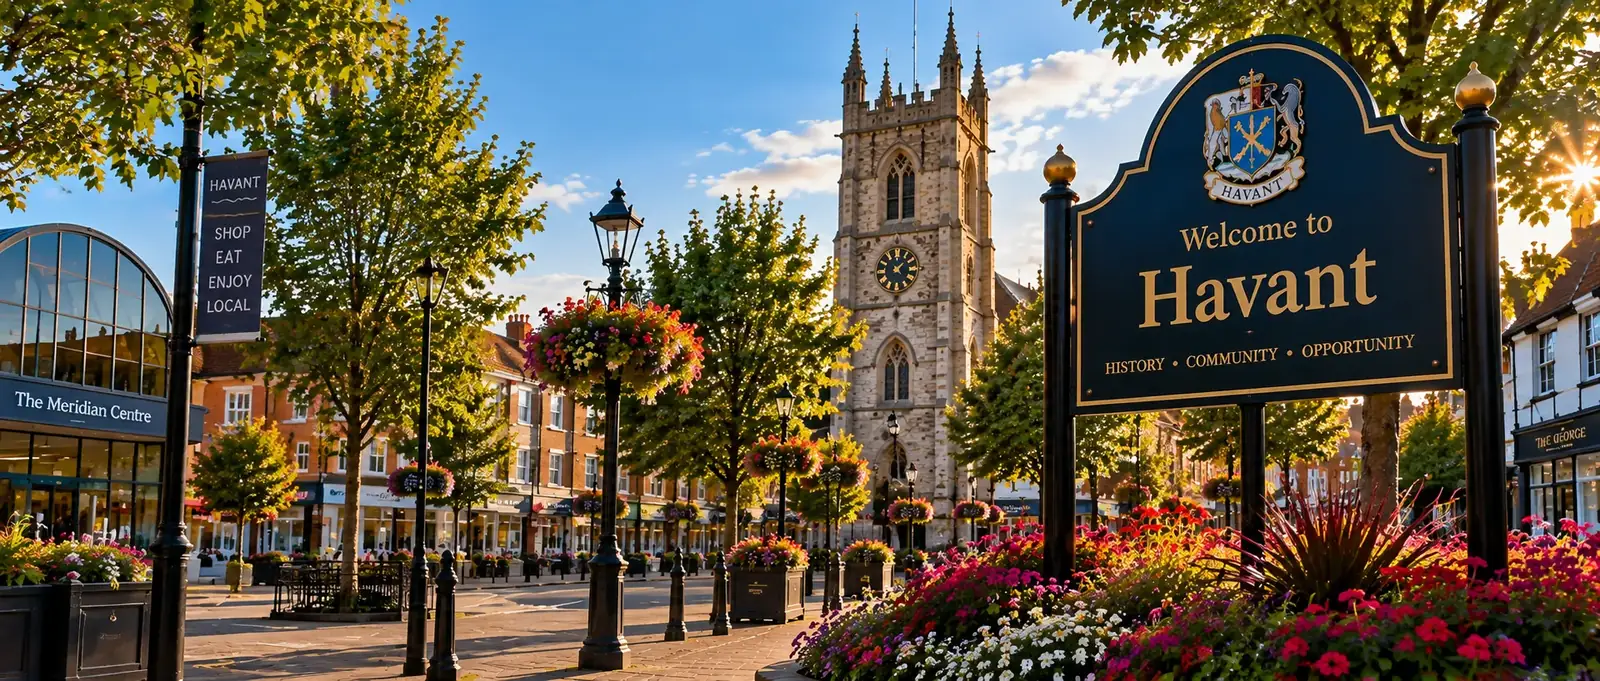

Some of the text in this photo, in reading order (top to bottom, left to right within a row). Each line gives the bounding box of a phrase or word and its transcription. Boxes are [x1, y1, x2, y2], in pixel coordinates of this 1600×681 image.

[209, 176, 261, 192] HAVANT
[1221, 177, 1283, 200] HAVANT
[214, 225, 251, 241] SHOP
[1180, 213, 1333, 251] Welcome to
[215, 249, 242, 265] EAT
[208, 274, 253, 289] ENJOY
[1138, 248, 1377, 329] Havant
[206, 298, 251, 313] LOCAL
[1105, 334, 1415, 375] HISTORY COMMUNITY OPPORTUNITY
[15, 391, 152, 423] The Meridian Centre
[1535, 435, 1551, 449] THE
